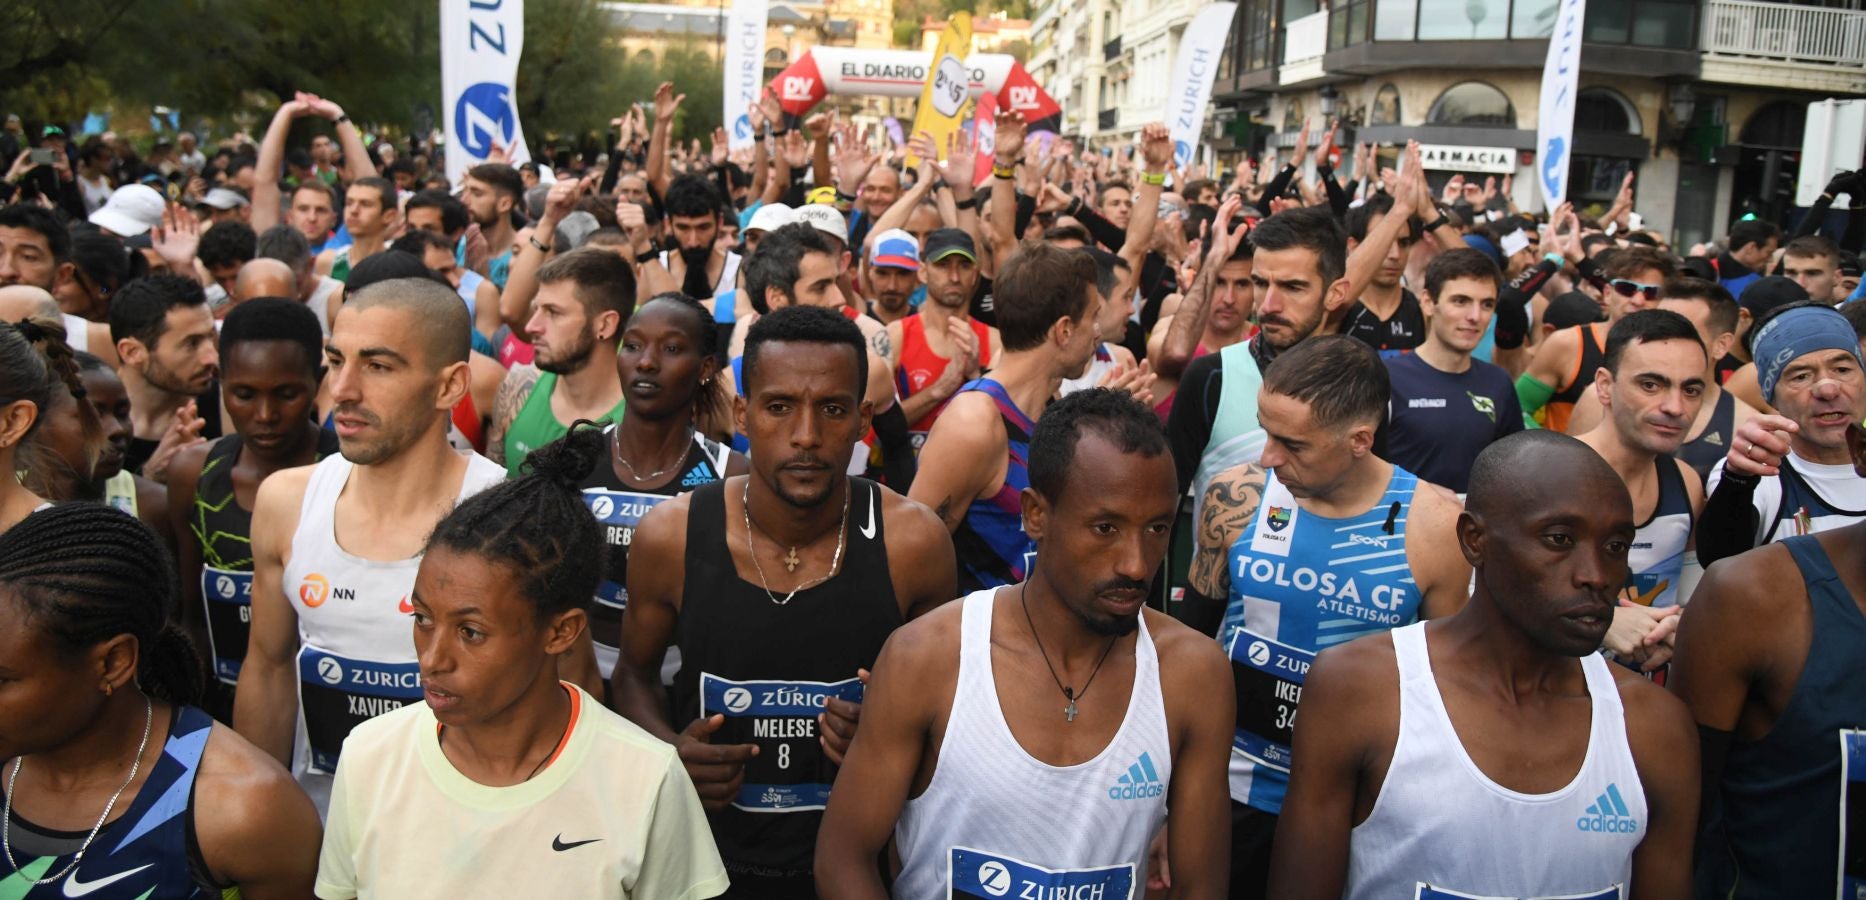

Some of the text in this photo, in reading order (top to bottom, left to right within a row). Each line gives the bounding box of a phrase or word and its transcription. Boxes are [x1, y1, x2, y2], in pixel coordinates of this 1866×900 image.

[742, 22, 758, 101] ZURICH
[842, 62, 924, 80] EL DIARIO
[784, 76, 814, 95] DV
[1009, 86, 1038, 103] DV
[1178, 47, 1209, 129] ZURICH
[606, 526, 635, 546] REB
[1237, 555, 1406, 612] TOLOSA CF
[333, 588, 355, 600] NN
[1316, 597, 1401, 624] ATLETISMO
[761, 691, 839, 708] ZURIC
[753, 718, 815, 738] MELESE
[777, 743, 790, 769] 8
[1109, 782, 1163, 800] adidas
[1577, 815, 1637, 833] adidas
